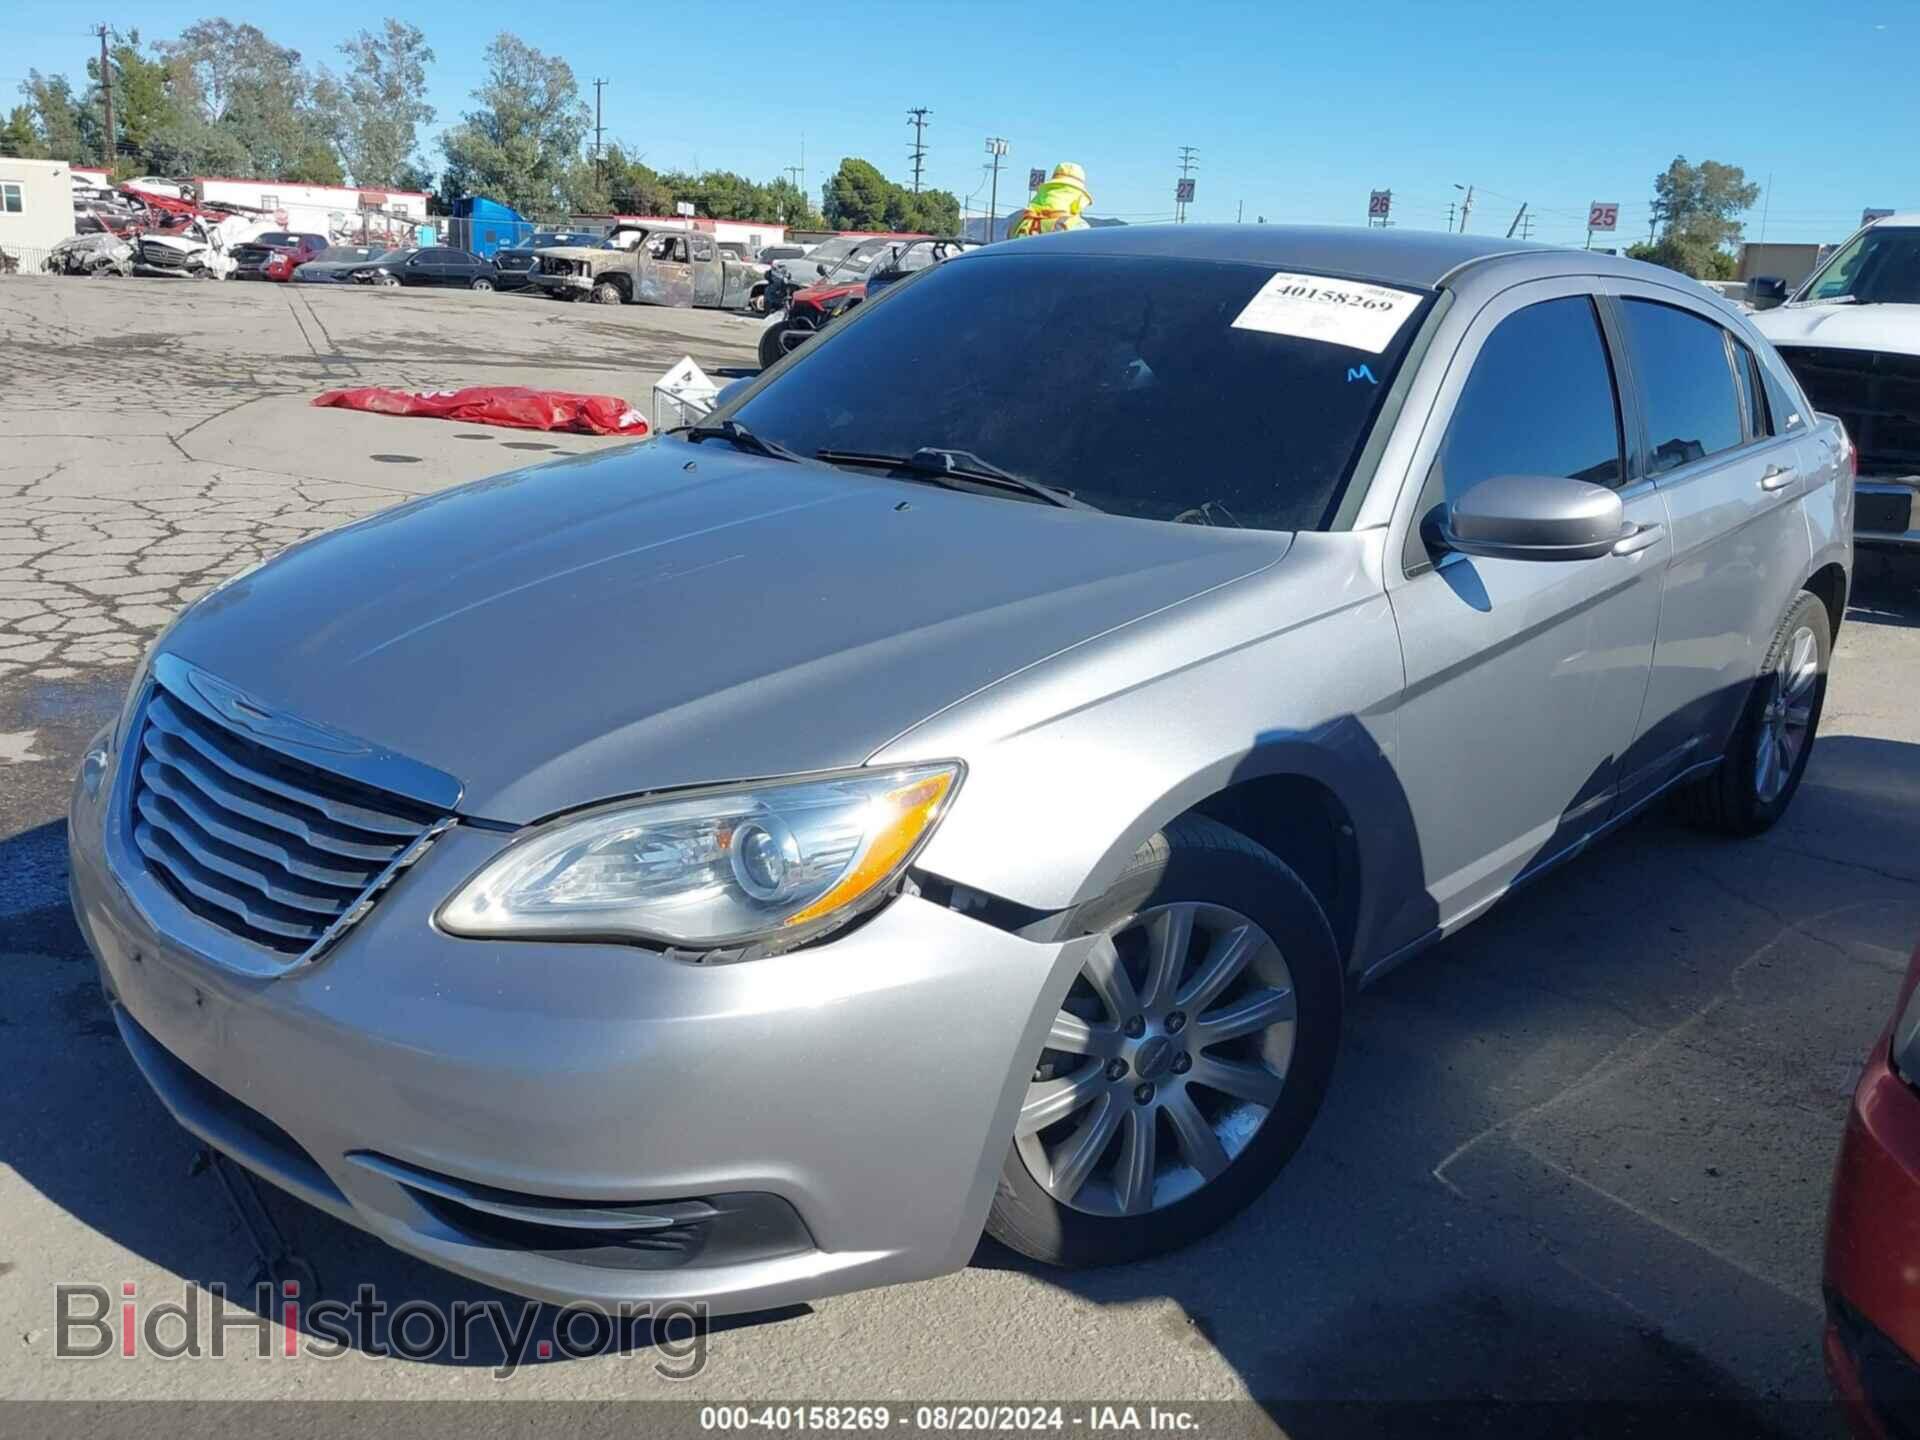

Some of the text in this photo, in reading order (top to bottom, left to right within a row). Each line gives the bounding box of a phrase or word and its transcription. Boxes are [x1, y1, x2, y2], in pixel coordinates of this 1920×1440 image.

[1177, 183, 1195, 198] 27
[1370, 197, 1390, 213] 26
[1591, 208, 1616, 226] 25
[1276, 285, 1393, 312] 40158269
